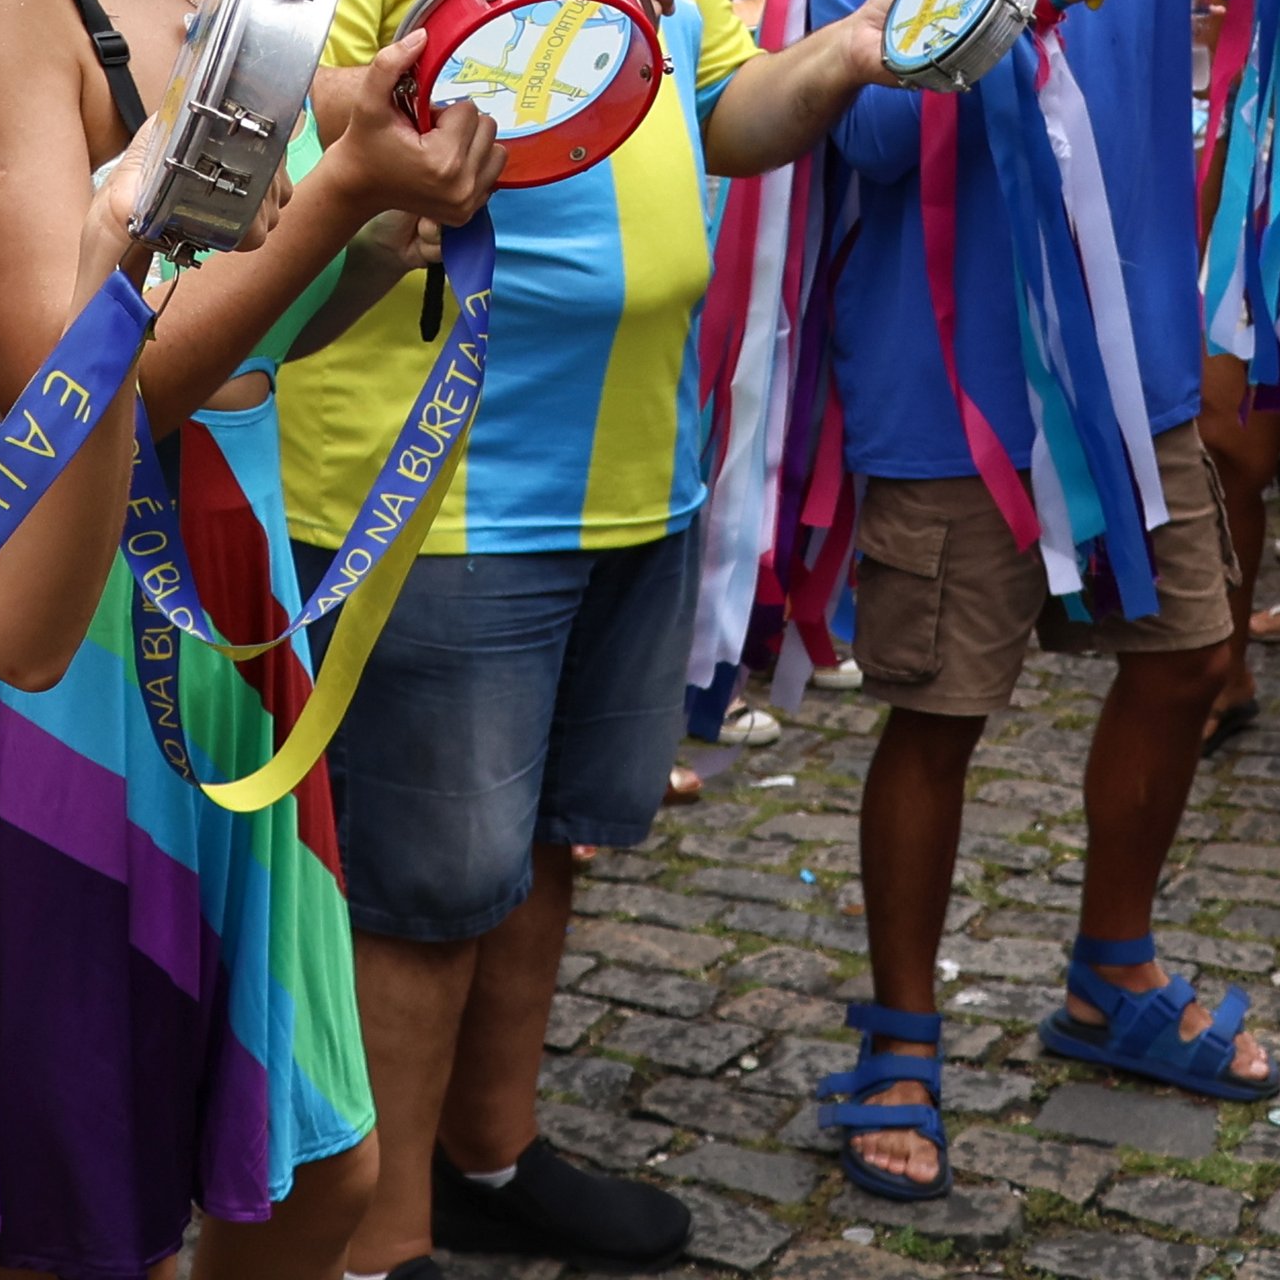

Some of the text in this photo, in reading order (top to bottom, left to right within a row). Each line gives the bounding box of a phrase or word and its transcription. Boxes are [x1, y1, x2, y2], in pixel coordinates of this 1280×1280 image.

[42, 370, 91, 424] É
[4, 409, 56, 459] A
[127, 530, 168, 556] O
[365, 492, 416, 544] NA
[146, 674, 179, 729] NA
